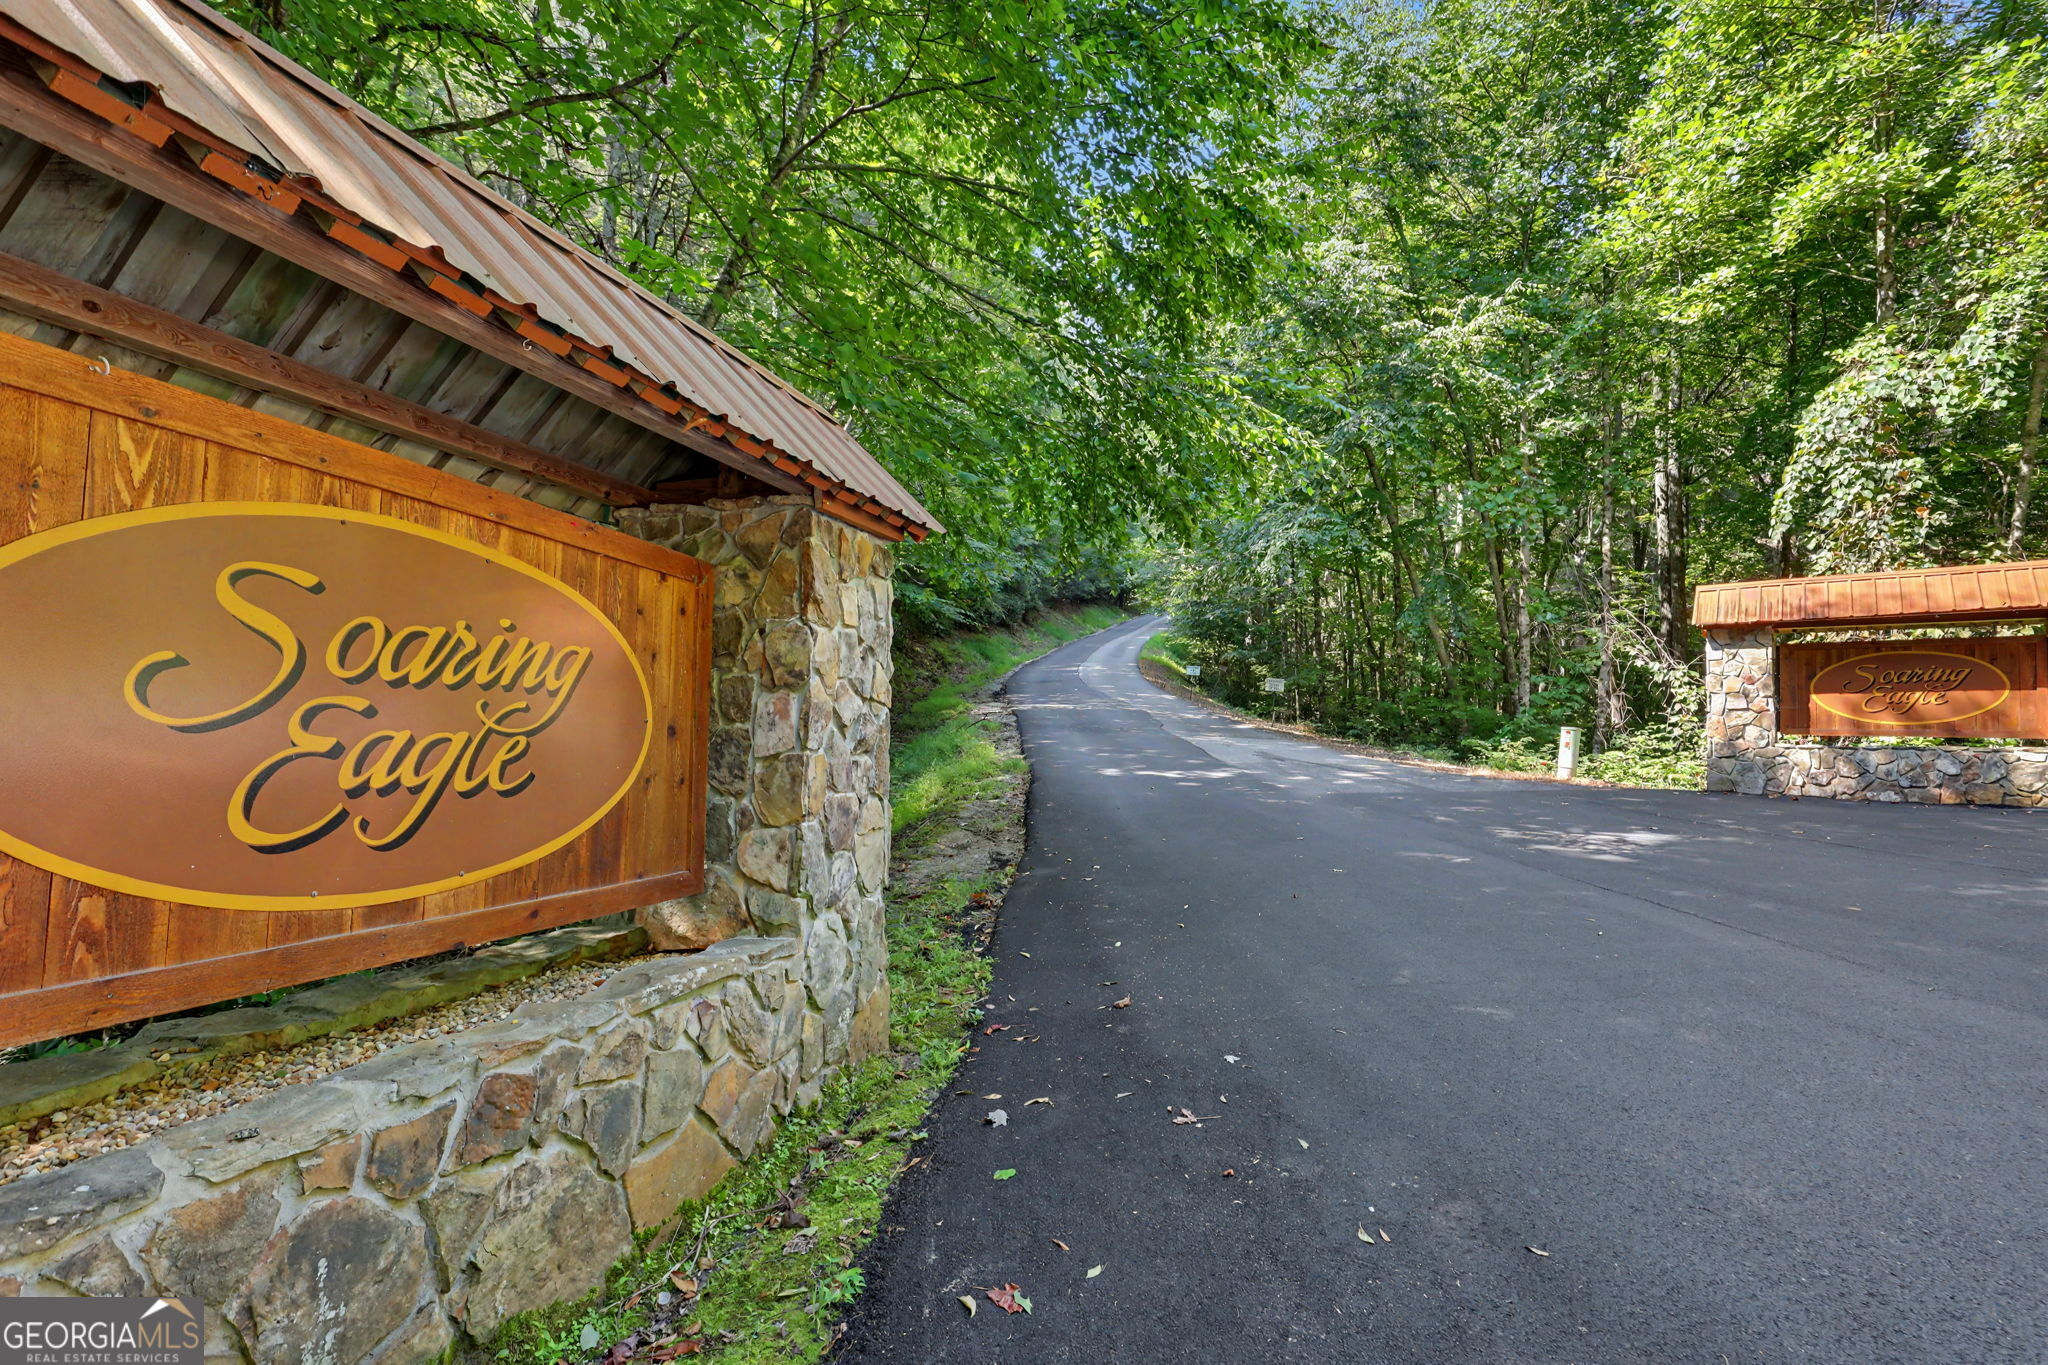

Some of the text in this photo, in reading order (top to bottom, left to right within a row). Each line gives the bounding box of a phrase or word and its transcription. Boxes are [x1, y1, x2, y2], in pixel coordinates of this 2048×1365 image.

[124, 560, 594, 733] Soaring
[1842, 664, 1973, 693] Soaring
[1861, 684, 1950, 714] Eagle
[227, 696, 535, 855] Eagle
